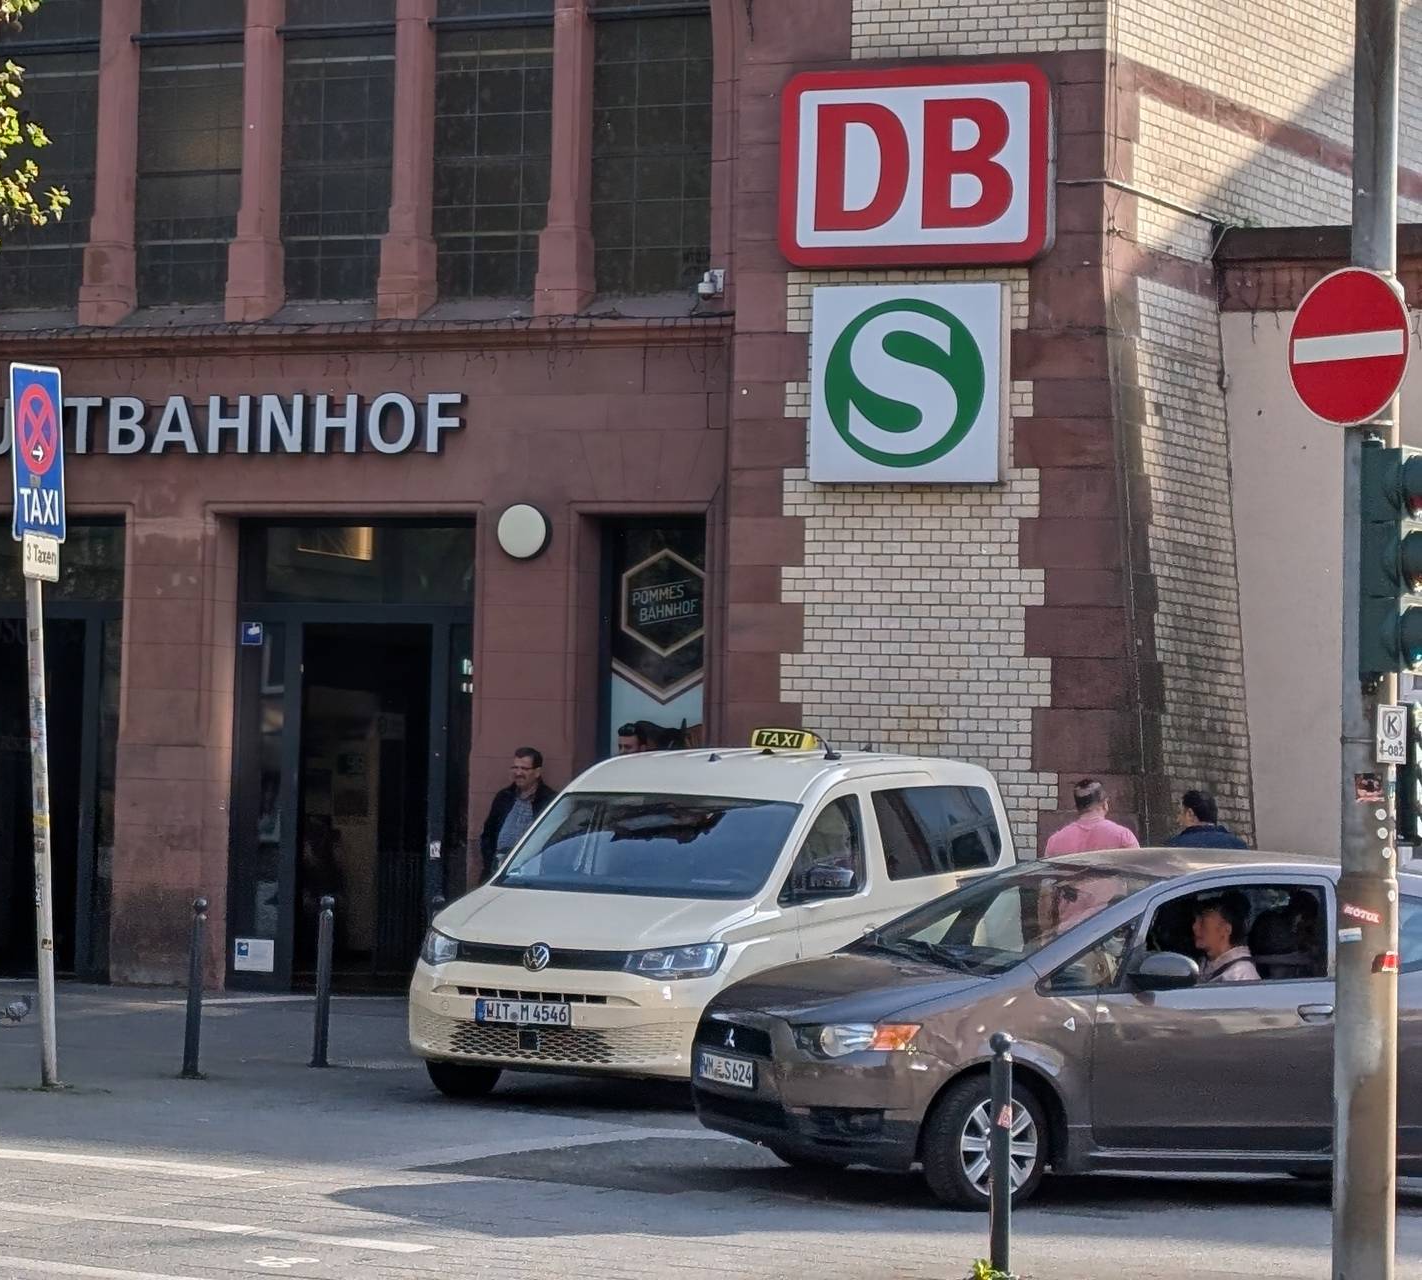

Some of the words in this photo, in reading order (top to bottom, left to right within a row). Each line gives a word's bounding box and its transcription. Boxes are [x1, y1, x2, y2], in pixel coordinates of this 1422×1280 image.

[814, 97, 1014, 231] DB
[847, 310, 958, 455] S
[19, 488, 59, 526] TAXI
[26, 543, 32, 561] 3
[33, 544, 57, 565] Taxen
[632, 584, 685, 606] POMMES
[639, 599, 699, 622] BAHNHOF
[1387, 715, 1398, 735] K
[761, 731, 800, 747] TAXI
[486, 1003, 510, 1020] WIT
[532, 1005, 567, 1023] 4546
